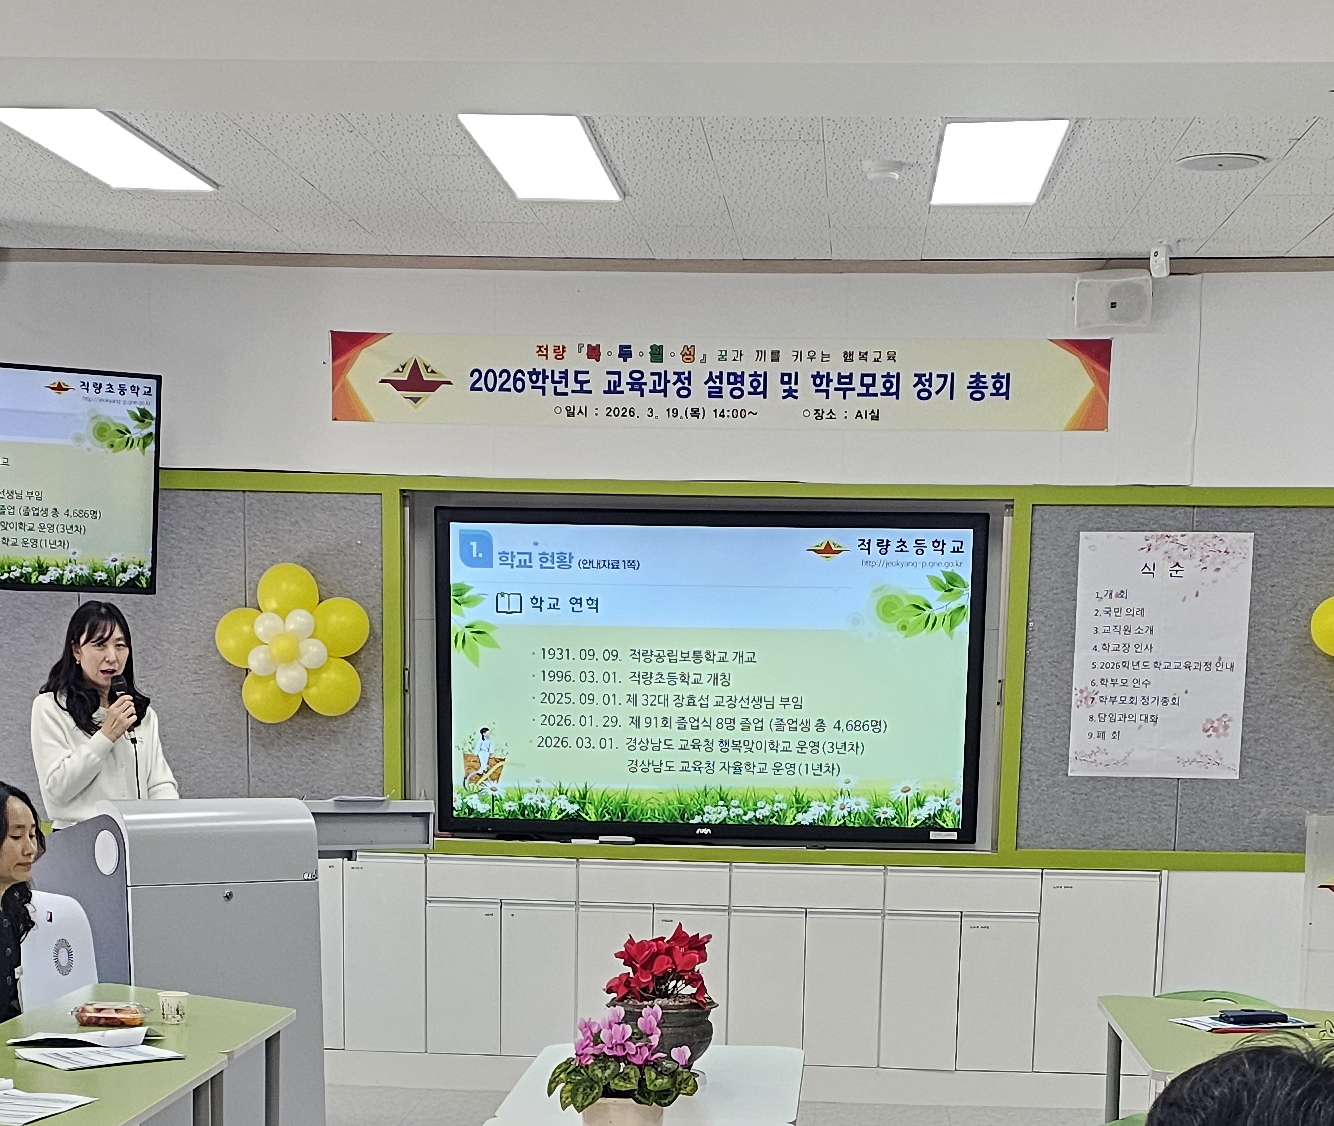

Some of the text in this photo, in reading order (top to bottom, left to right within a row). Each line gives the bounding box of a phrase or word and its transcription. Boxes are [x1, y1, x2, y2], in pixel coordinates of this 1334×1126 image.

[536, 344, 567, 361] 적량
[718, 350, 744, 363] 꿈과
[792, 351, 831, 363] 키우는
[843, 351, 898, 364] 행복교육
[469, 368, 1011, 401] 2026학년도 교육과정 설명회 및 학부모회 정기 총회
[605, 407, 640, 419] 2026.
[647, 408, 659, 420] 3.
[666, 408, 706, 420] 19.(목)
[855, 409, 880, 421] AI실
[26, 491, 43, 501] 부임
[470, 542, 483, 558] 1.
[858, 538, 965, 556] 적량초등학교
[498, 551, 534, 569] 학교
[538, 552, 574, 570] 현황
[1141, 562, 1185, 579] 식 순
[530, 595, 599, 614] 학교 연혁
[1125, 607, 1145, 618] 의례
[1134, 625, 1154, 635] 소개
[541, 648, 758, 664] 1931. 09. 09. 적량공립보통학교 개교
[1134, 643, 1154, 653] 인사
[1153, 661, 1213, 672] 학교교육과정
[1215, 661, 1235, 672] 안내
[541, 670, 731, 687] 1996. 03. 01. 적량초등학교 개칭
[540, 692, 803, 710] 2025. 09. 01. 제 32대 장효섭 교장선생님 부임
[540, 714, 888, 734] 2026. 01. 29. 제 91회 졸업식 8명 졸업 (졸업생 총 4,686명)
[1140, 713, 1159, 724] 대화
[537, 736, 865, 755] 2026. 03. 01. 경상남도 교육청 행복맞이학교 운영(3년차)
[627, 760, 841, 777] 경상남도 교육청 자율학교 운영(1년차)
